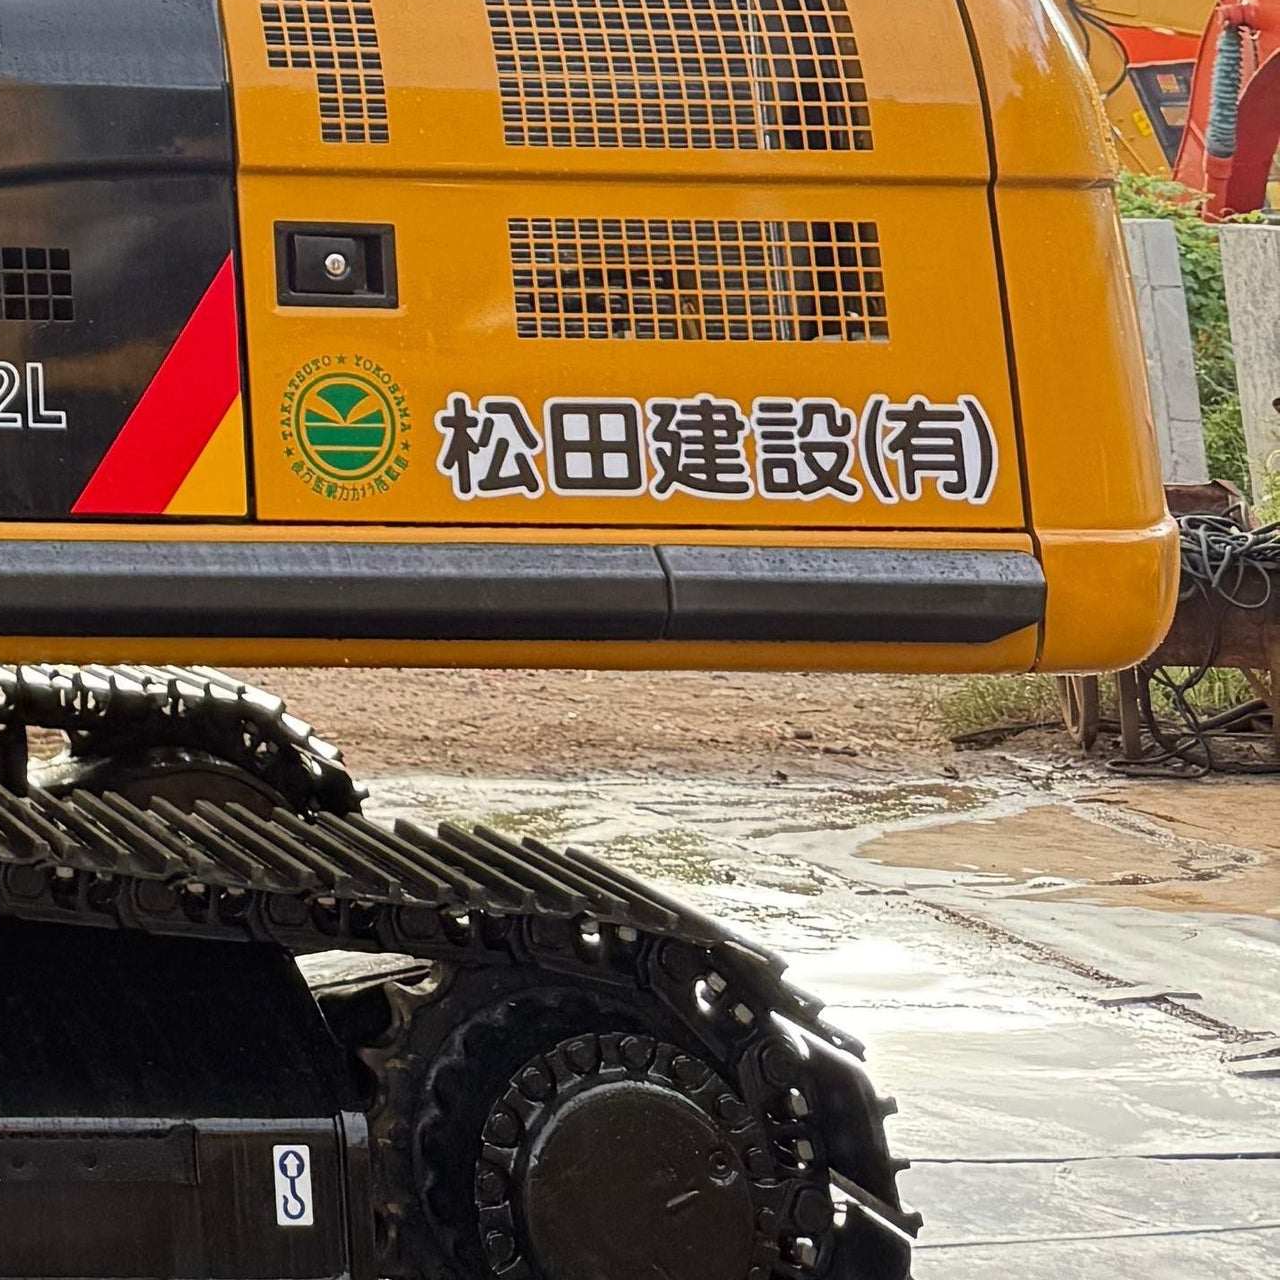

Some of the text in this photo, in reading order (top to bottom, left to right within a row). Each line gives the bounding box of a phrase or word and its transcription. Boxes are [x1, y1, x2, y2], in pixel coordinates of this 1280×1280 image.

[437, 393, 998, 504] 松田建設(有)
